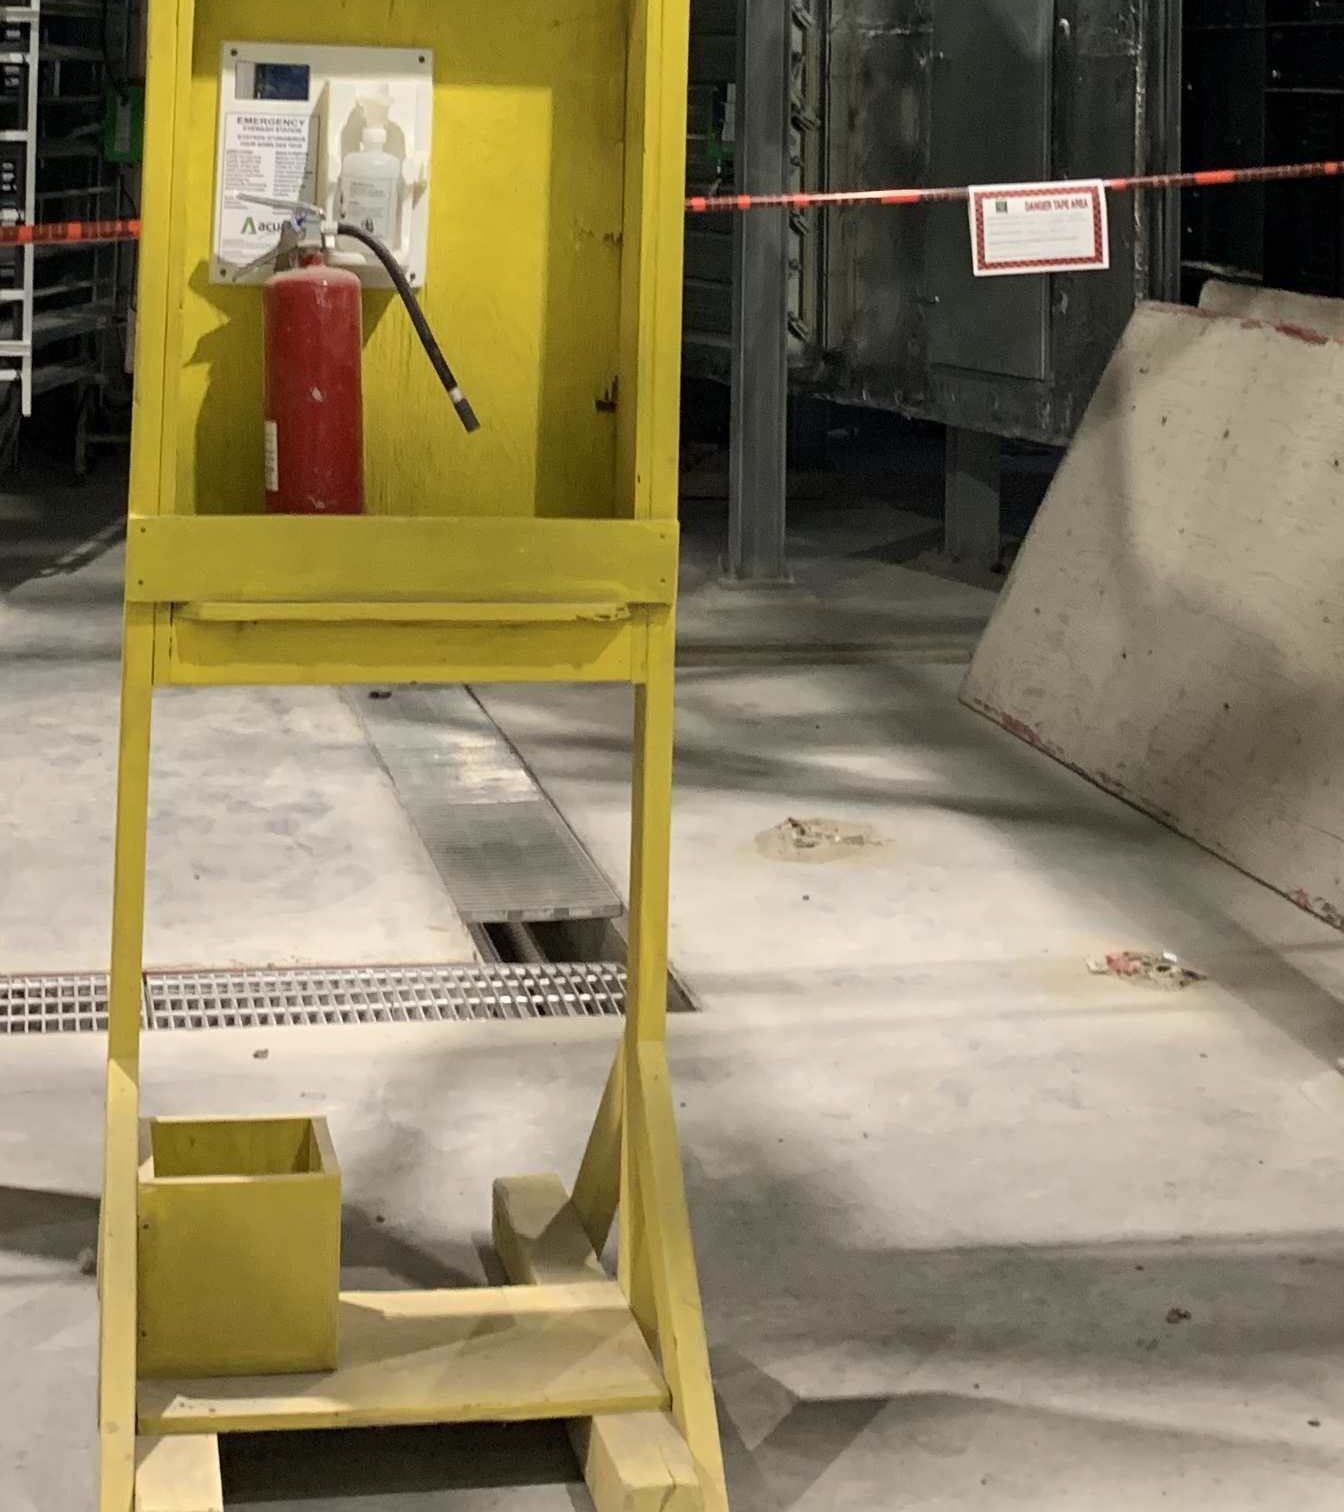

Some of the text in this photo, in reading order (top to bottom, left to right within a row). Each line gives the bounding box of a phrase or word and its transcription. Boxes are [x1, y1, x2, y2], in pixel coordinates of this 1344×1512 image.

[237, 116, 305, 127] EMERGENCY
[1025, 197, 1089, 212] DANGER TAPE AREA
